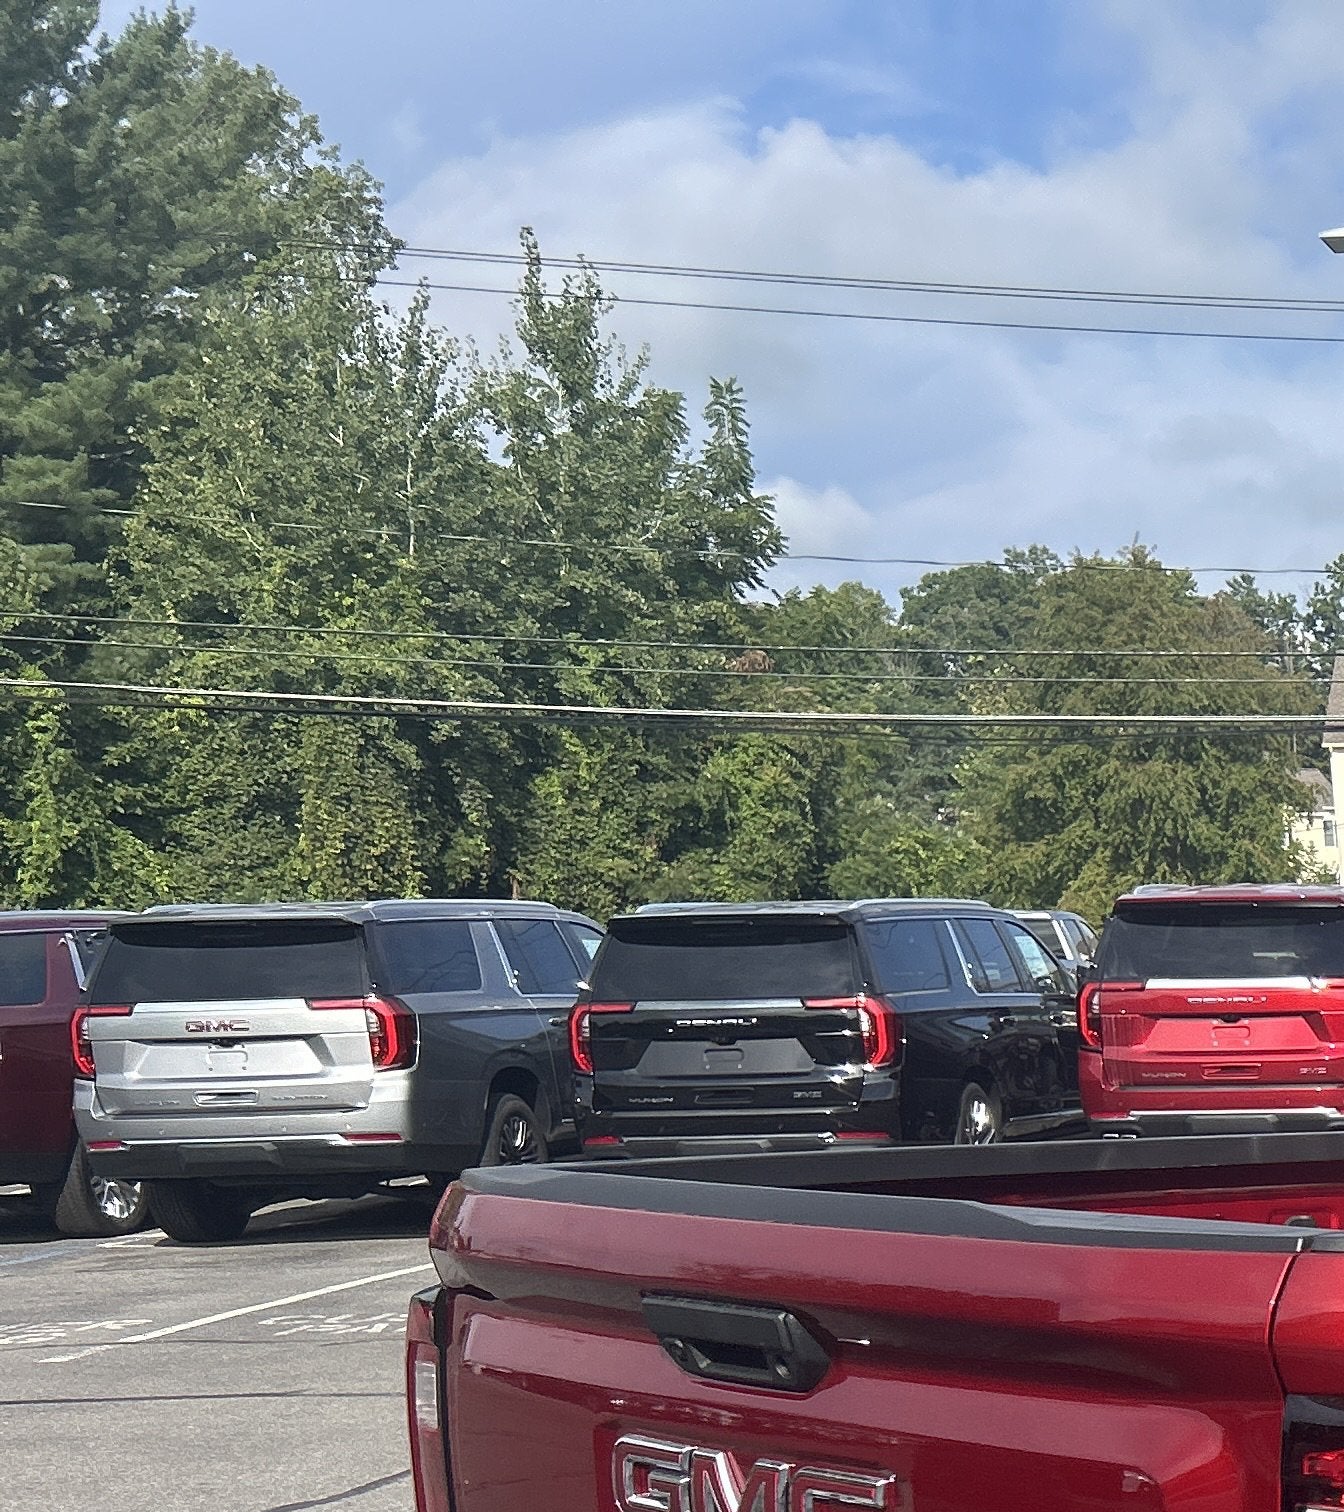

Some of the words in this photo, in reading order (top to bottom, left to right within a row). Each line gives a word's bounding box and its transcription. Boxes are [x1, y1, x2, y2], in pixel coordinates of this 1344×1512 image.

[1187, 996, 1268, 1004] DENALI
[185, 1019, 250, 1032] GMC
[676, 1017, 758, 1027] DENALI
